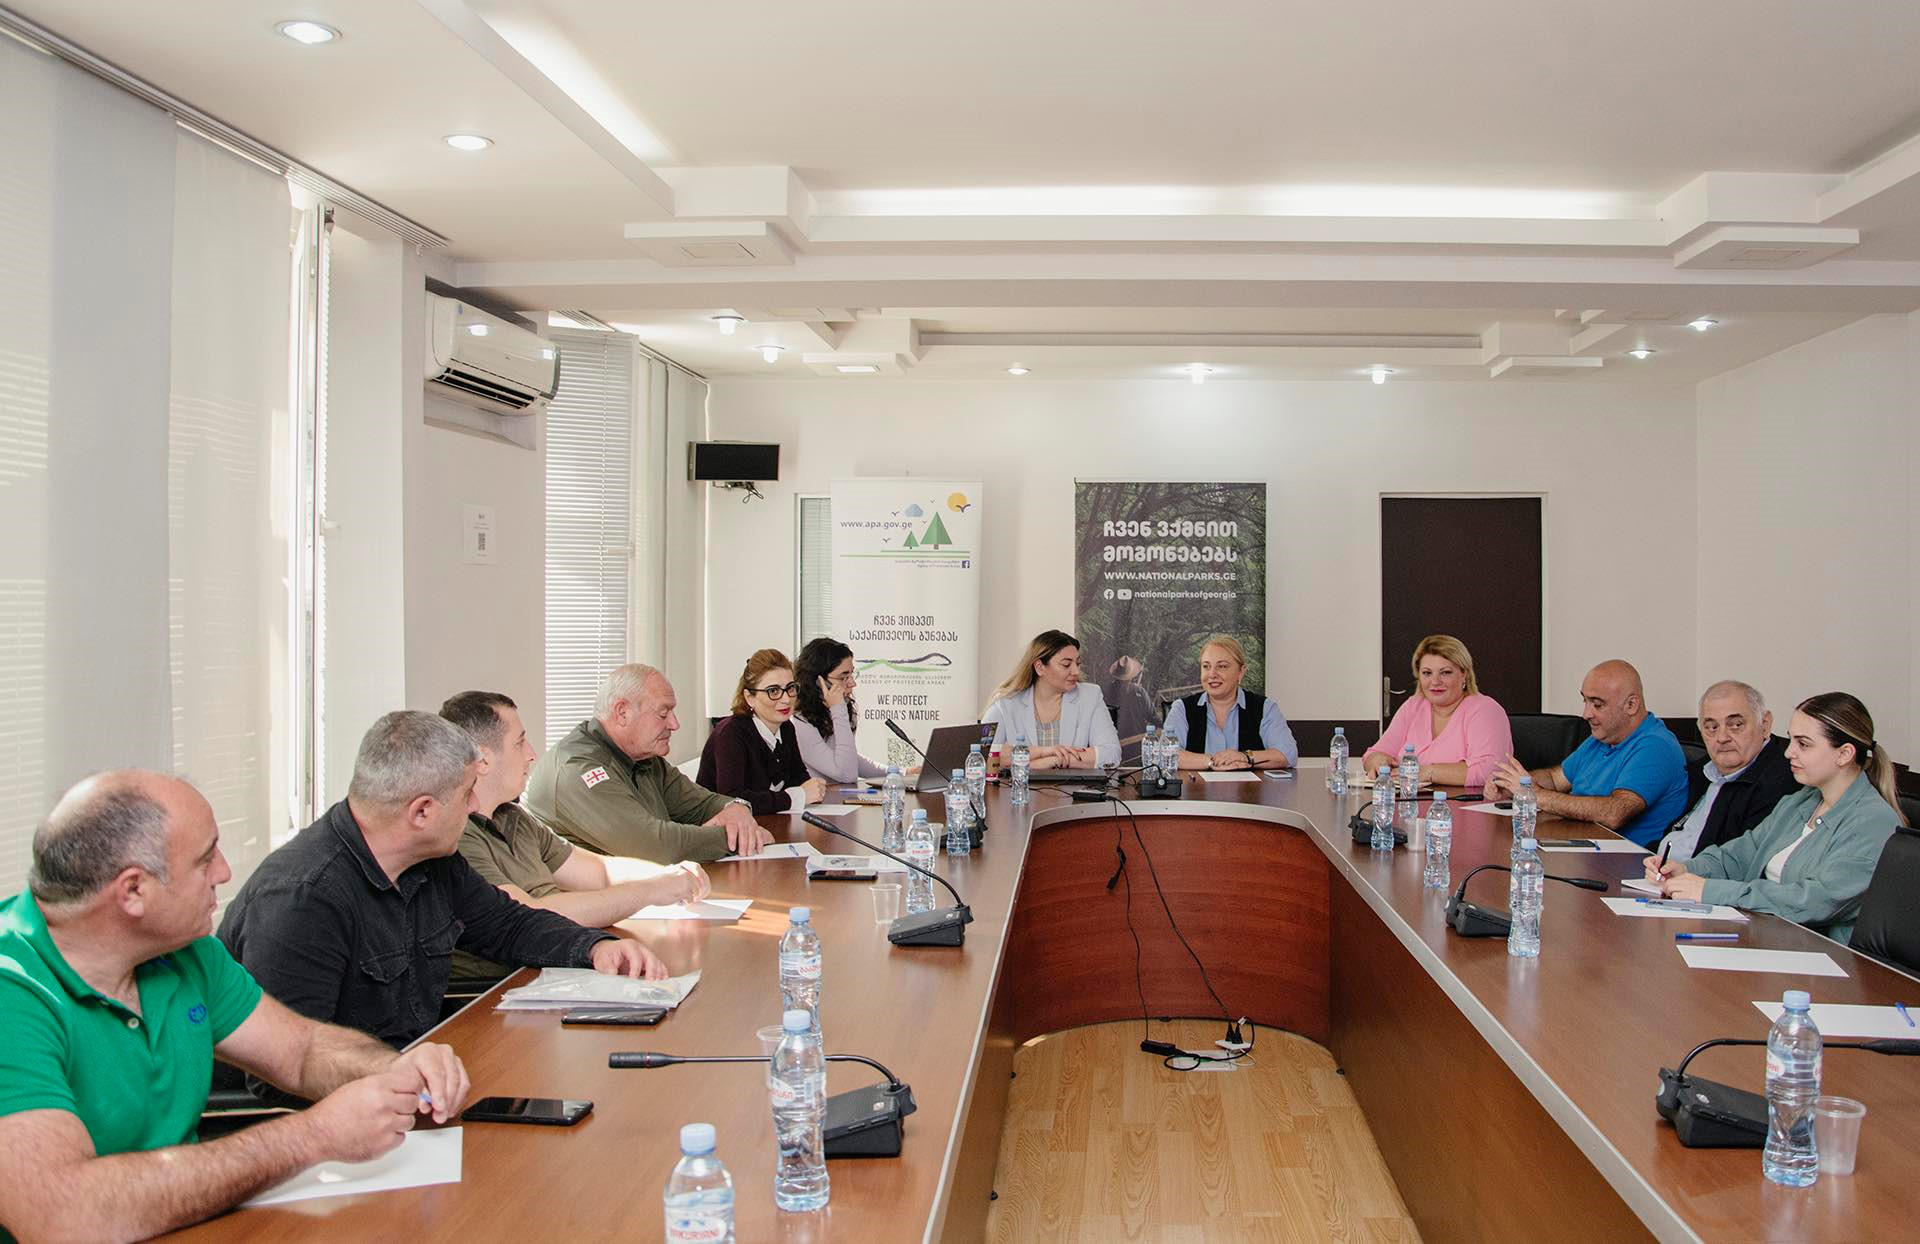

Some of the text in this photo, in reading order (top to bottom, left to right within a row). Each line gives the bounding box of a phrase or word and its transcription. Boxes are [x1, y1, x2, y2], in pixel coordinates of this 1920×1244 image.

[840, 520, 913, 529] www.apa.gov.ge
[1103, 520, 1237, 537] ჩვენ ვქმნით
[1103, 545, 1237, 563] მოგონებებს
[1104, 572, 1236, 581] WWW.NATIONALPARKS.GE
[1134, 589, 1237, 600] nationalparksofgeorgia
[873, 614, 896, 626] ჩვენ
[877, 694, 928, 706] WE PROTECT
[864, 709, 940, 721] GEORGIA'S NATURE
